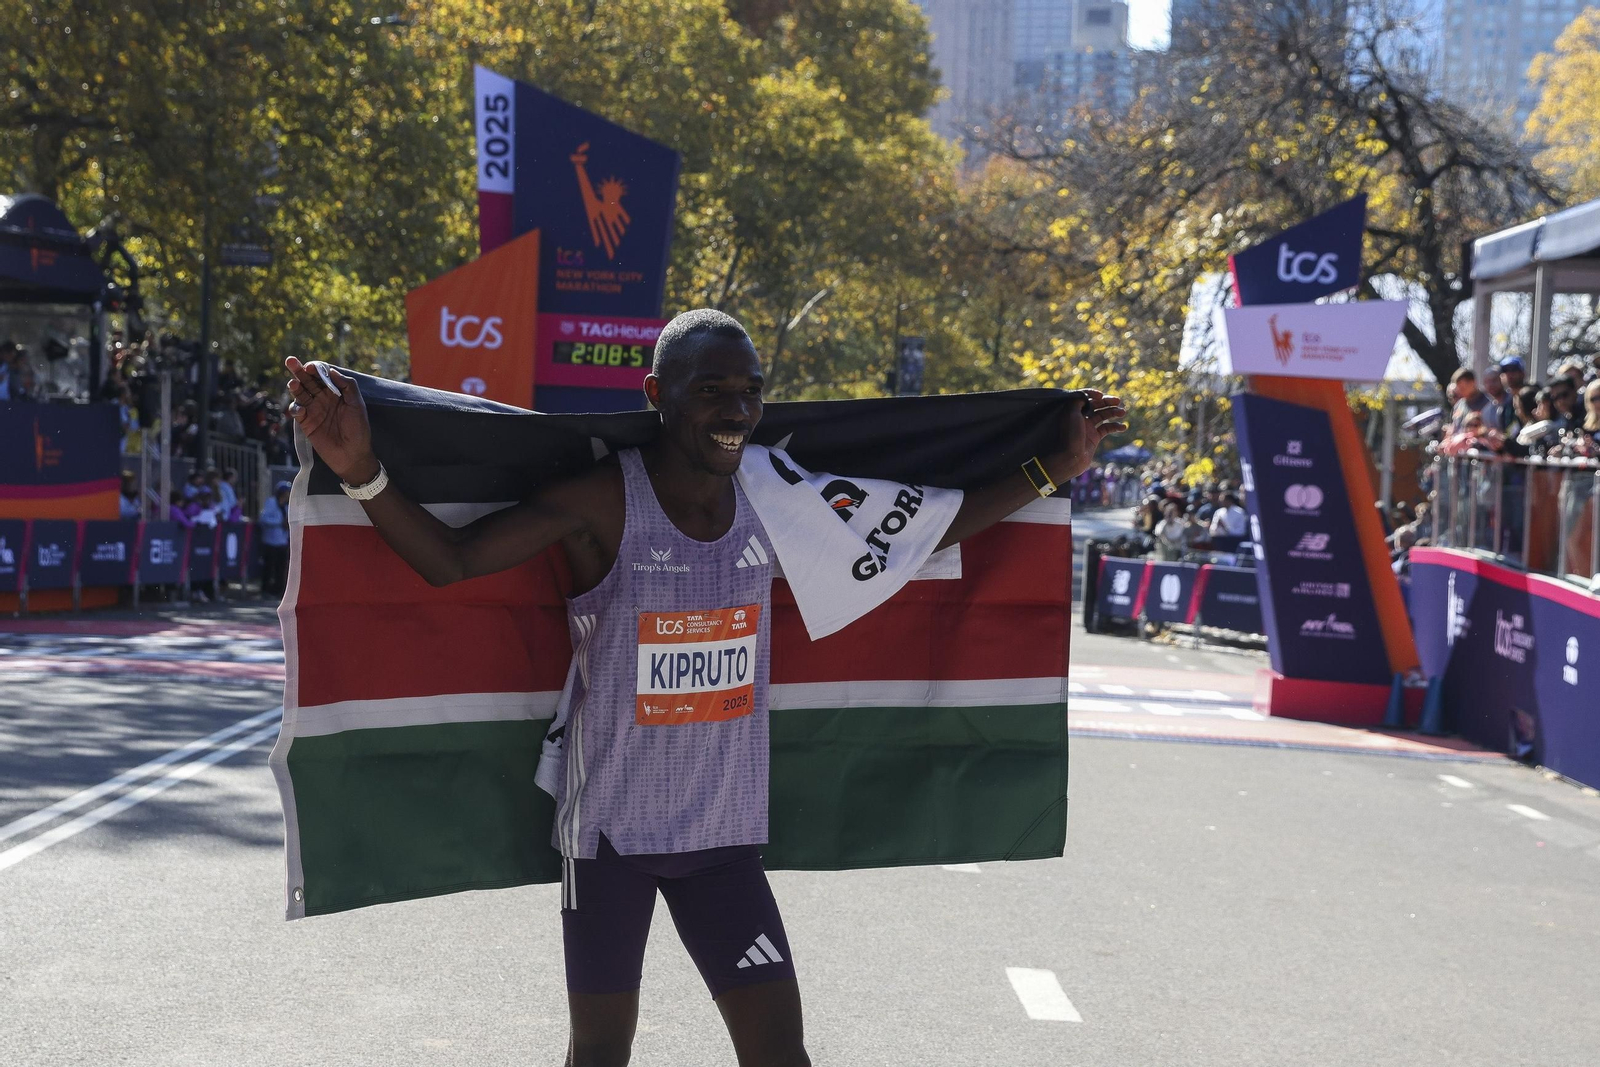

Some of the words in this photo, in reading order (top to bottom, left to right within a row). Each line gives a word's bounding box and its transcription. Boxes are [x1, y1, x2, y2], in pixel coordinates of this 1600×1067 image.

[485, 94, 509, 178] 2025
[1277, 243, 1339, 284] tcs
[556, 269, 582, 279] NEW
[587, 270, 614, 280] YORK
[619, 271, 643, 282] CITY
[556, 281, 622, 293] MARATHON
[441, 306, 503, 350] tcs
[631, 562, 661, 573] Tirop's
[662, 563, 690, 574] Angels
[656, 617, 684, 635] tcs
[687, 619, 723, 628] CONSULTANCY
[687, 626, 711, 634] SERVICES
[731, 622, 747, 630] TATA
[650, 645, 748, 689] KIPRUTO
[723, 694, 748, 711] 2025
